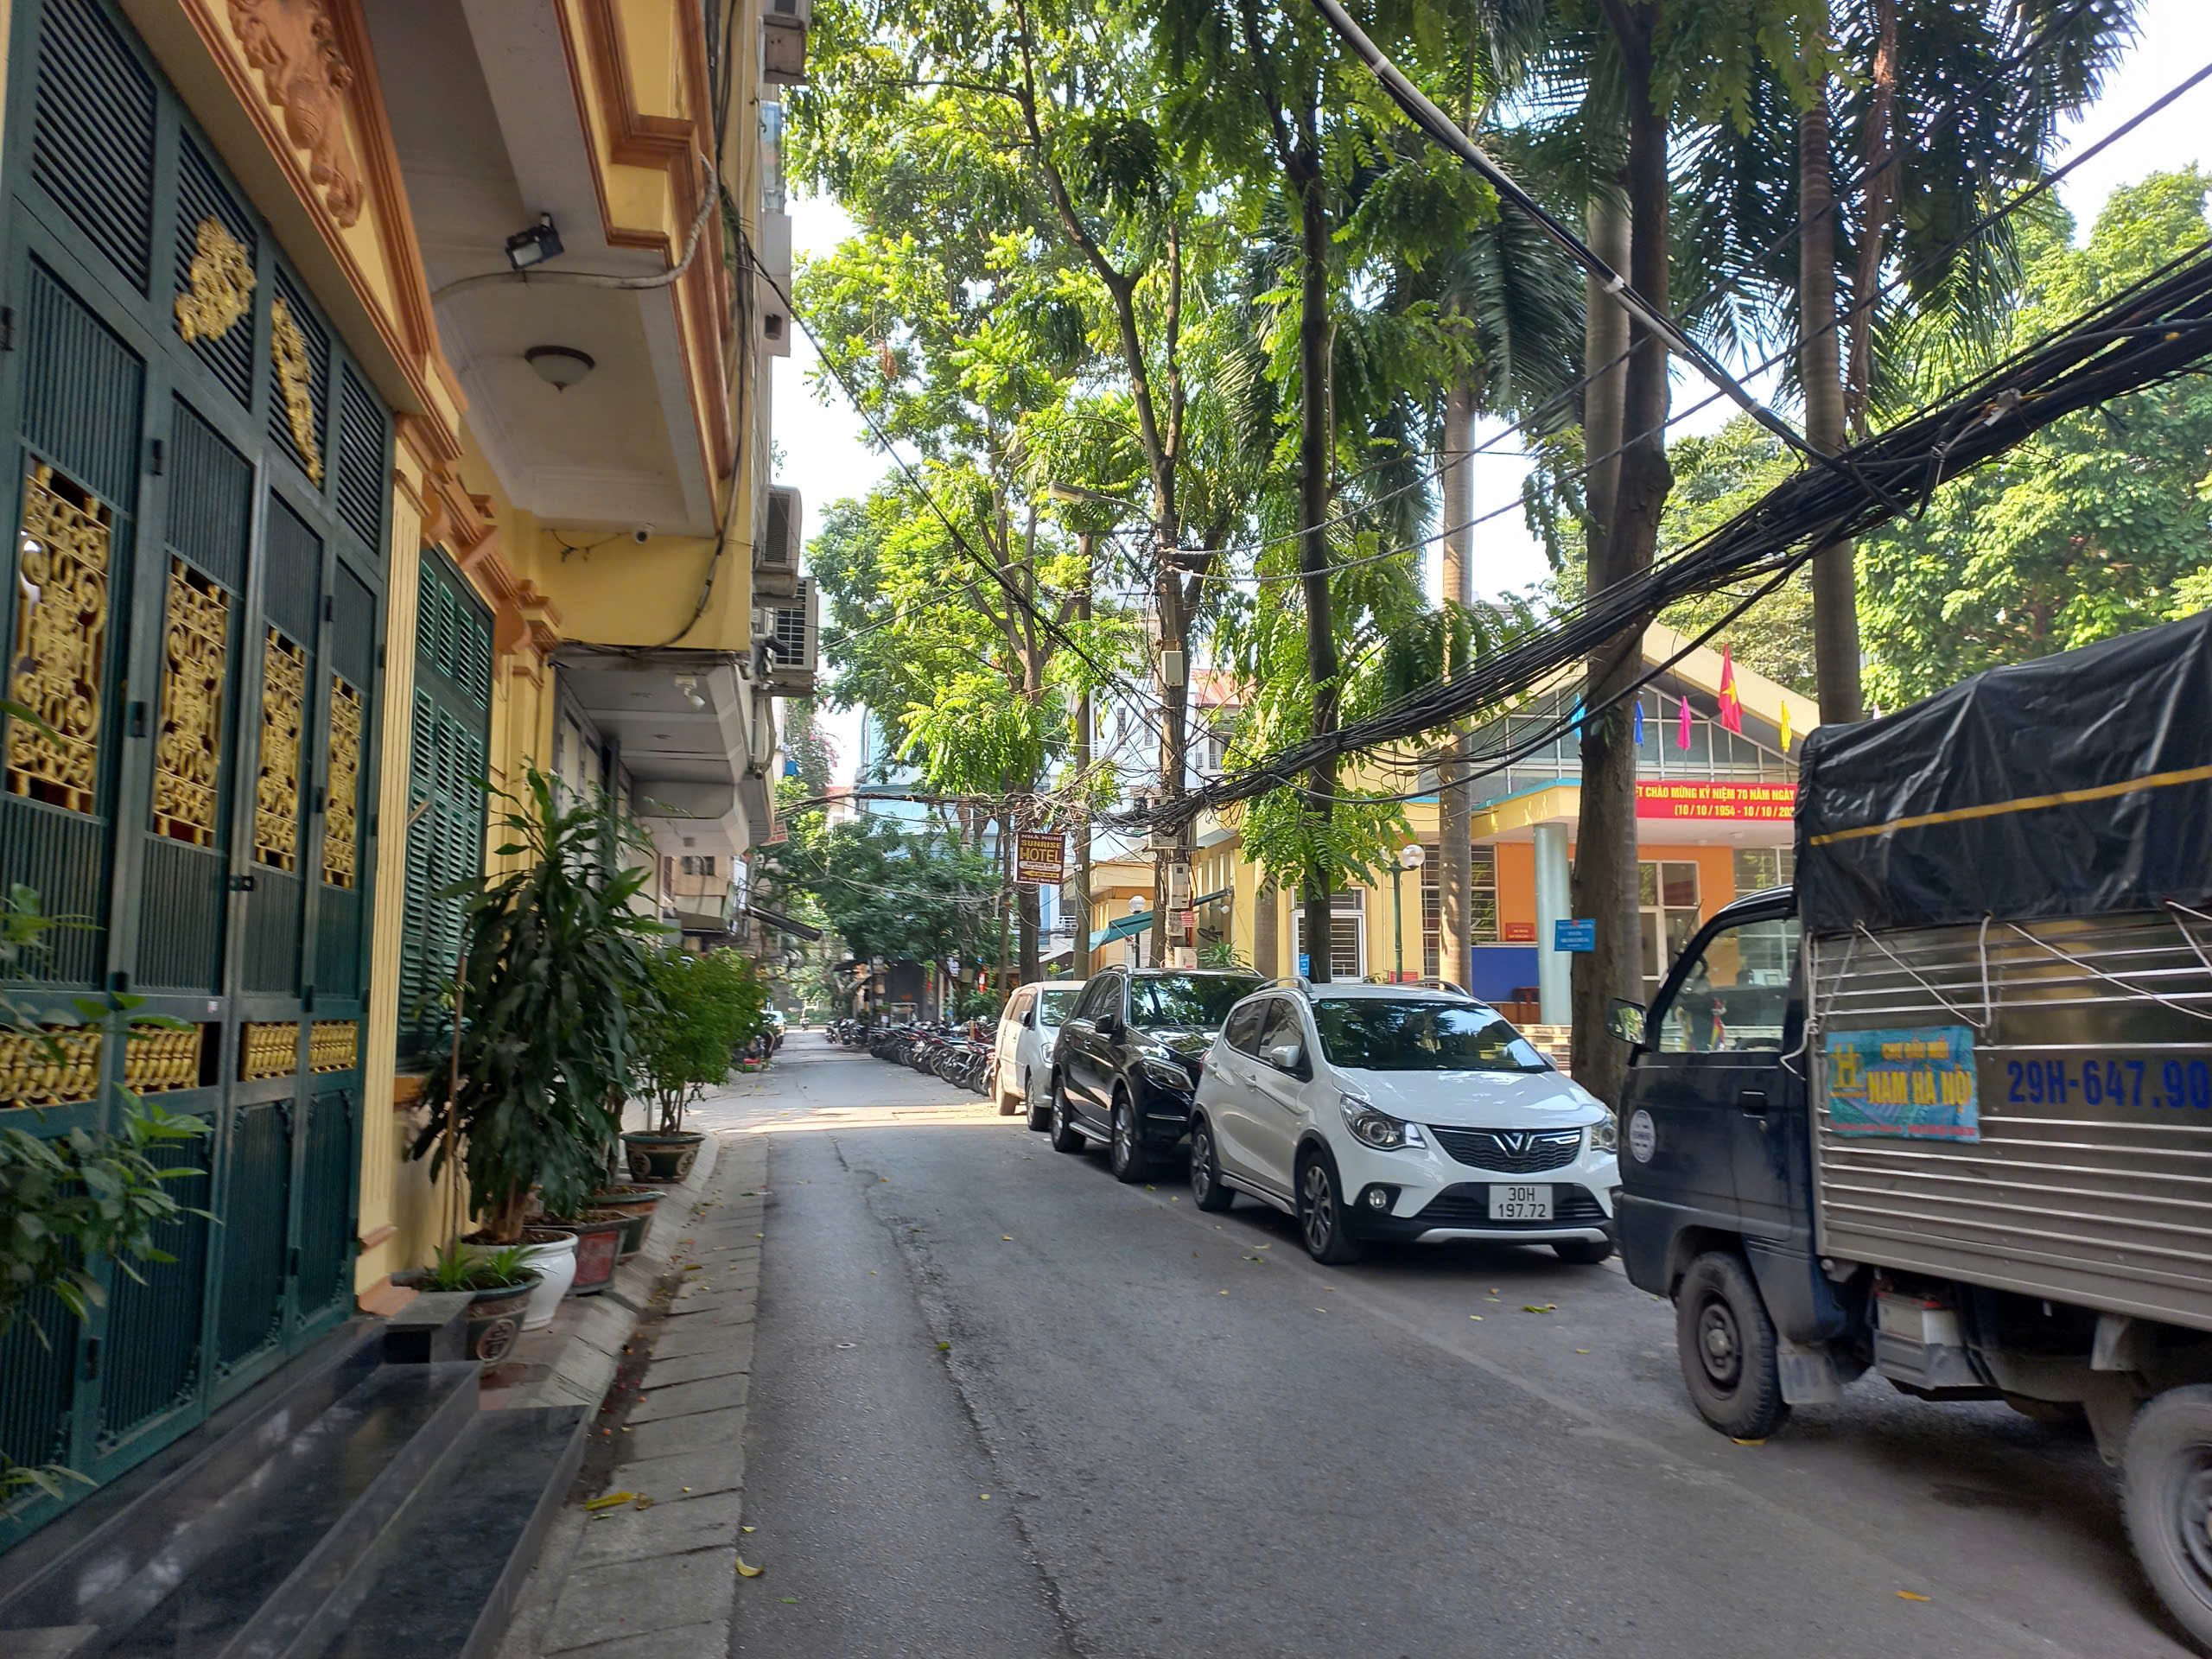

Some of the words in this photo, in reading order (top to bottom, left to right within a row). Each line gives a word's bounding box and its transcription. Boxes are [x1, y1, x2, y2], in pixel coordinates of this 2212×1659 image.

[1645, 785, 1669, 798] CHÀO
[1670, 785, 1697, 799] MỪNG
[1712, 785, 1736, 802] NIỆM
[1737, 788, 1748, 800] 70
[1750, 787, 1770, 800] NĂM
[1771, 787, 1795, 801] NGÀY
[1020, 839, 1062, 849] SUNRISE
[1020, 847, 1062, 863] HOTEL
[1866, 1071, 1909, 1105] NAM
[1911, 1064, 1937, 1106] HÀ
[1940, 1064, 1973, 1113] NỘI
[2006, 1059, 2212, 1109] 29H-647.90
[1508, 1187, 1535, 1202] 30H
[1497, 1203, 1547, 1217] 197.72
